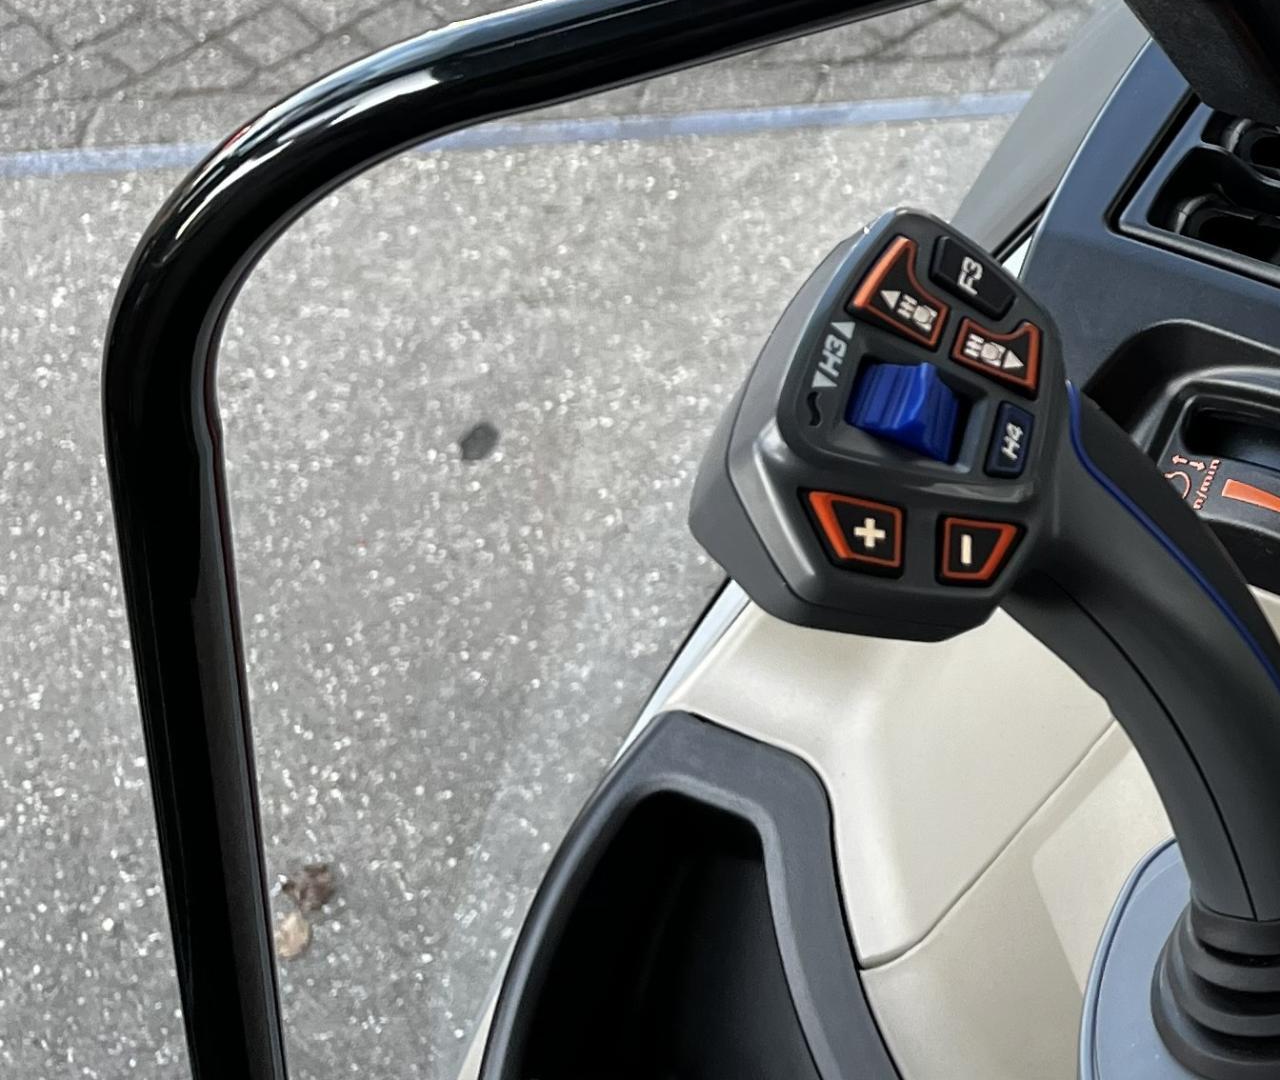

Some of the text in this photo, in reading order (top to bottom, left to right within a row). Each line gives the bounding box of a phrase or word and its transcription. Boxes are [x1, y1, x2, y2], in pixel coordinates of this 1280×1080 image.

[957, 256, 984, 296] F3
[817, 335, 848, 379] H3
[1002, 423, 1024, 461] H4
